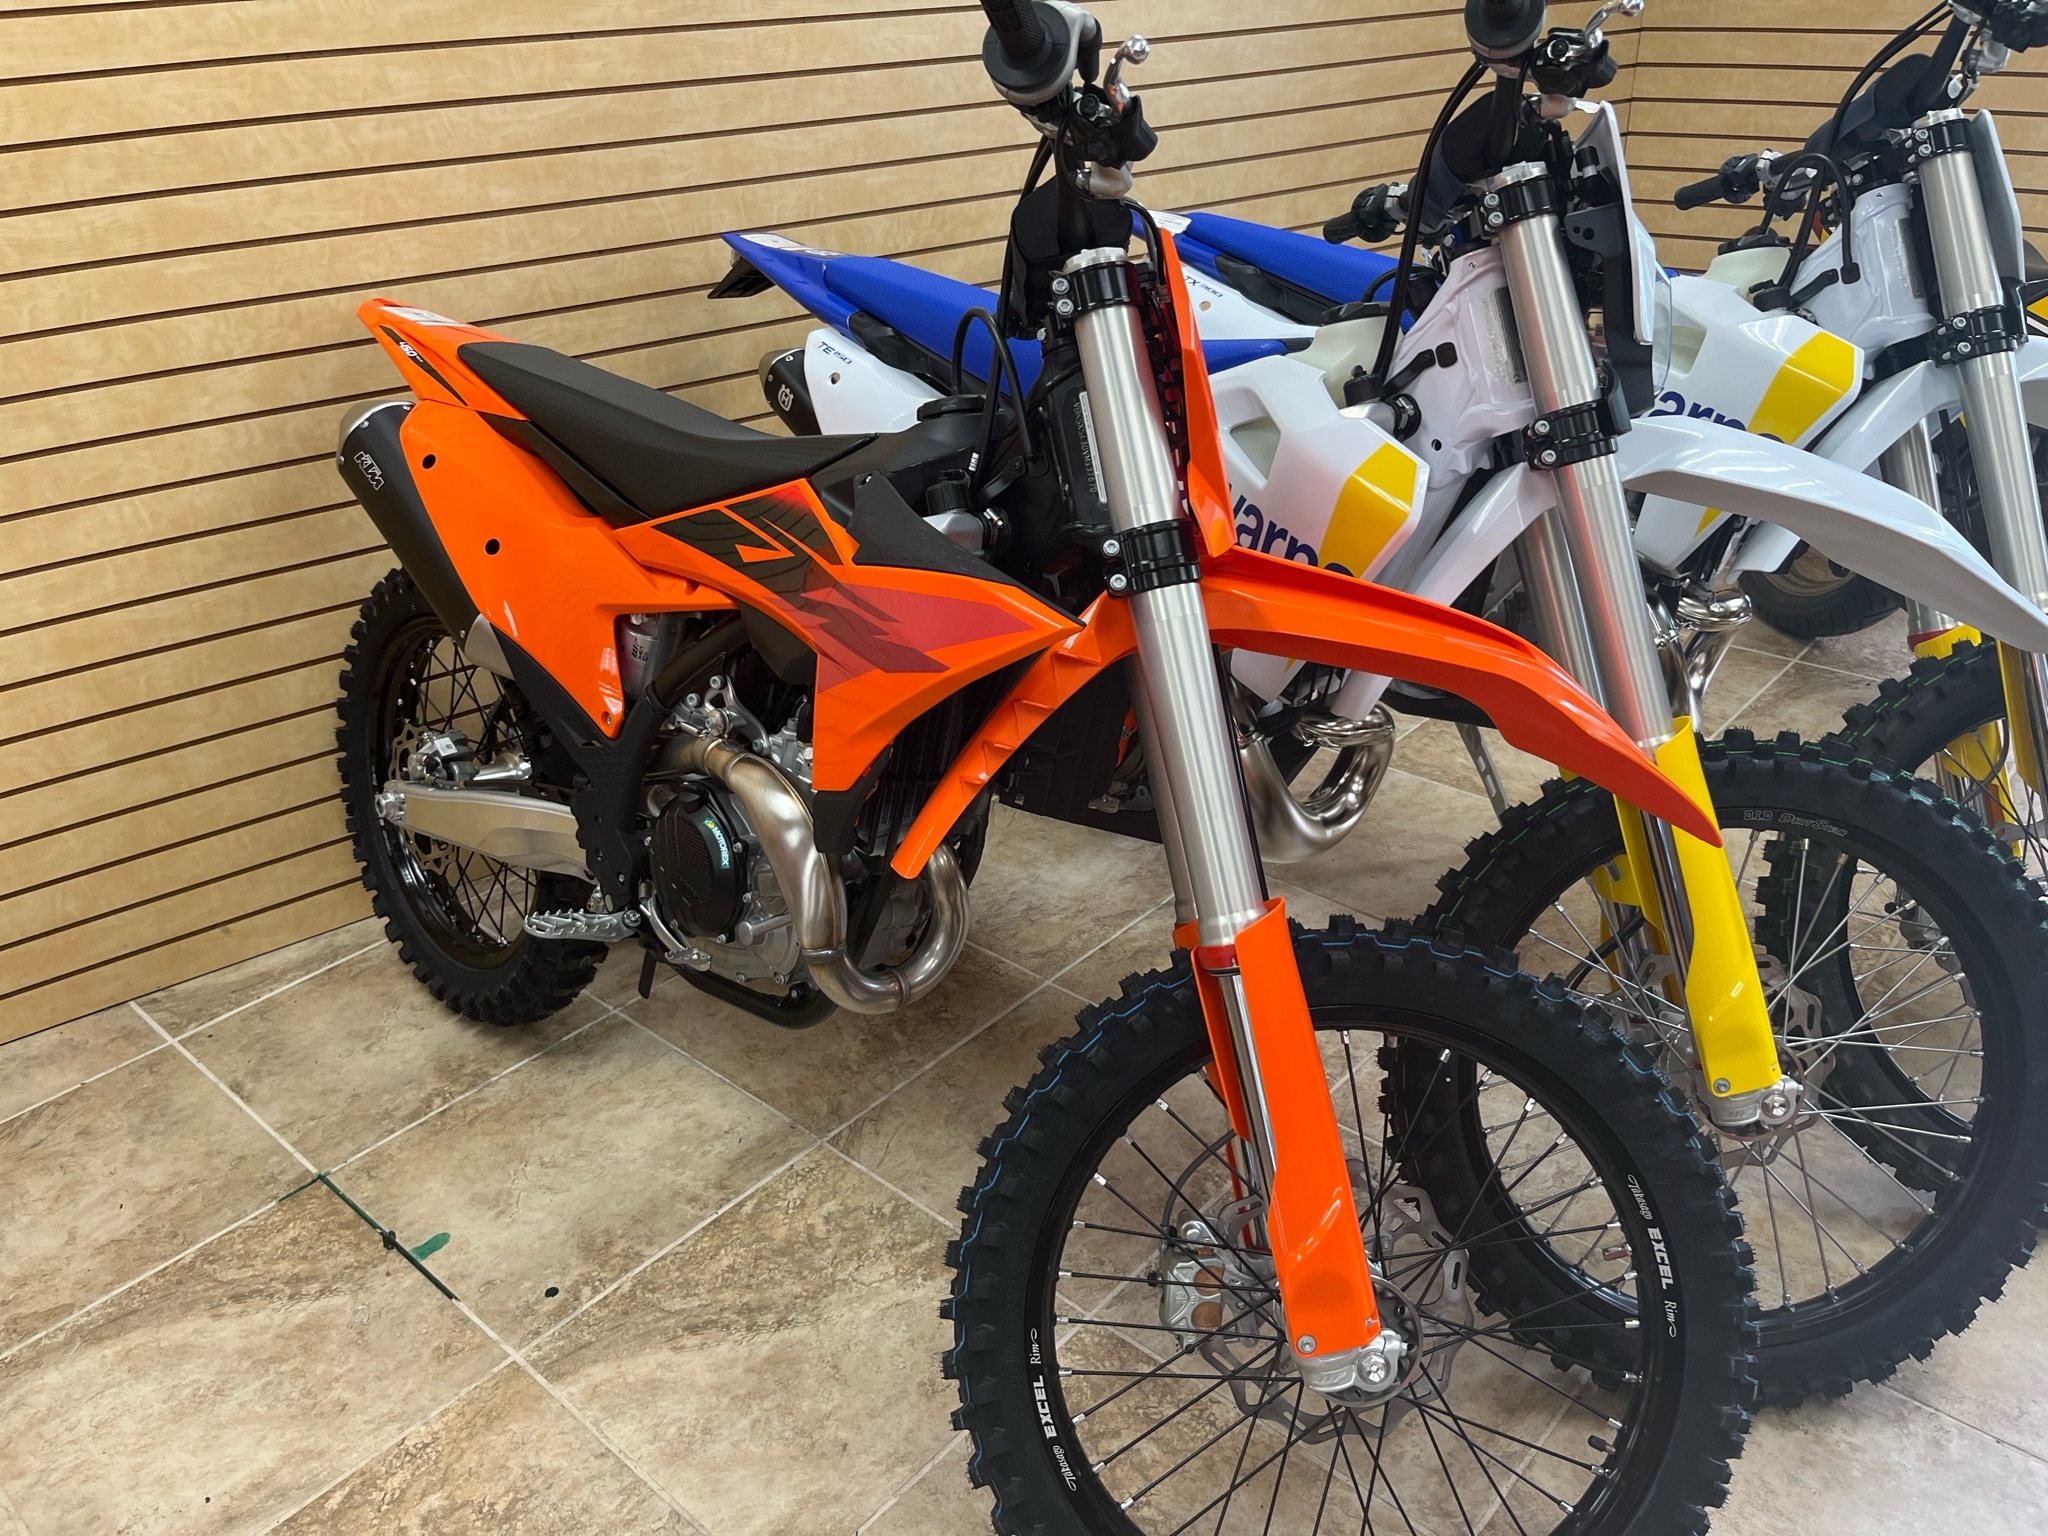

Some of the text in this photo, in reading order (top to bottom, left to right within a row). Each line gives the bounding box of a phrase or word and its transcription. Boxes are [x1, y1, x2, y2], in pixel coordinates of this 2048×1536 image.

[398, 340, 418, 358] 450
[817, 341, 853, 365] TE 150
[353, 450, 385, 491] KTM
[711, 825, 730, 867] MOTOREX
[1627, 1173, 1678, 1339] Takasago EXCEL Rim
[1030, 1327, 1078, 1492] Takasago EXCEL Rim
